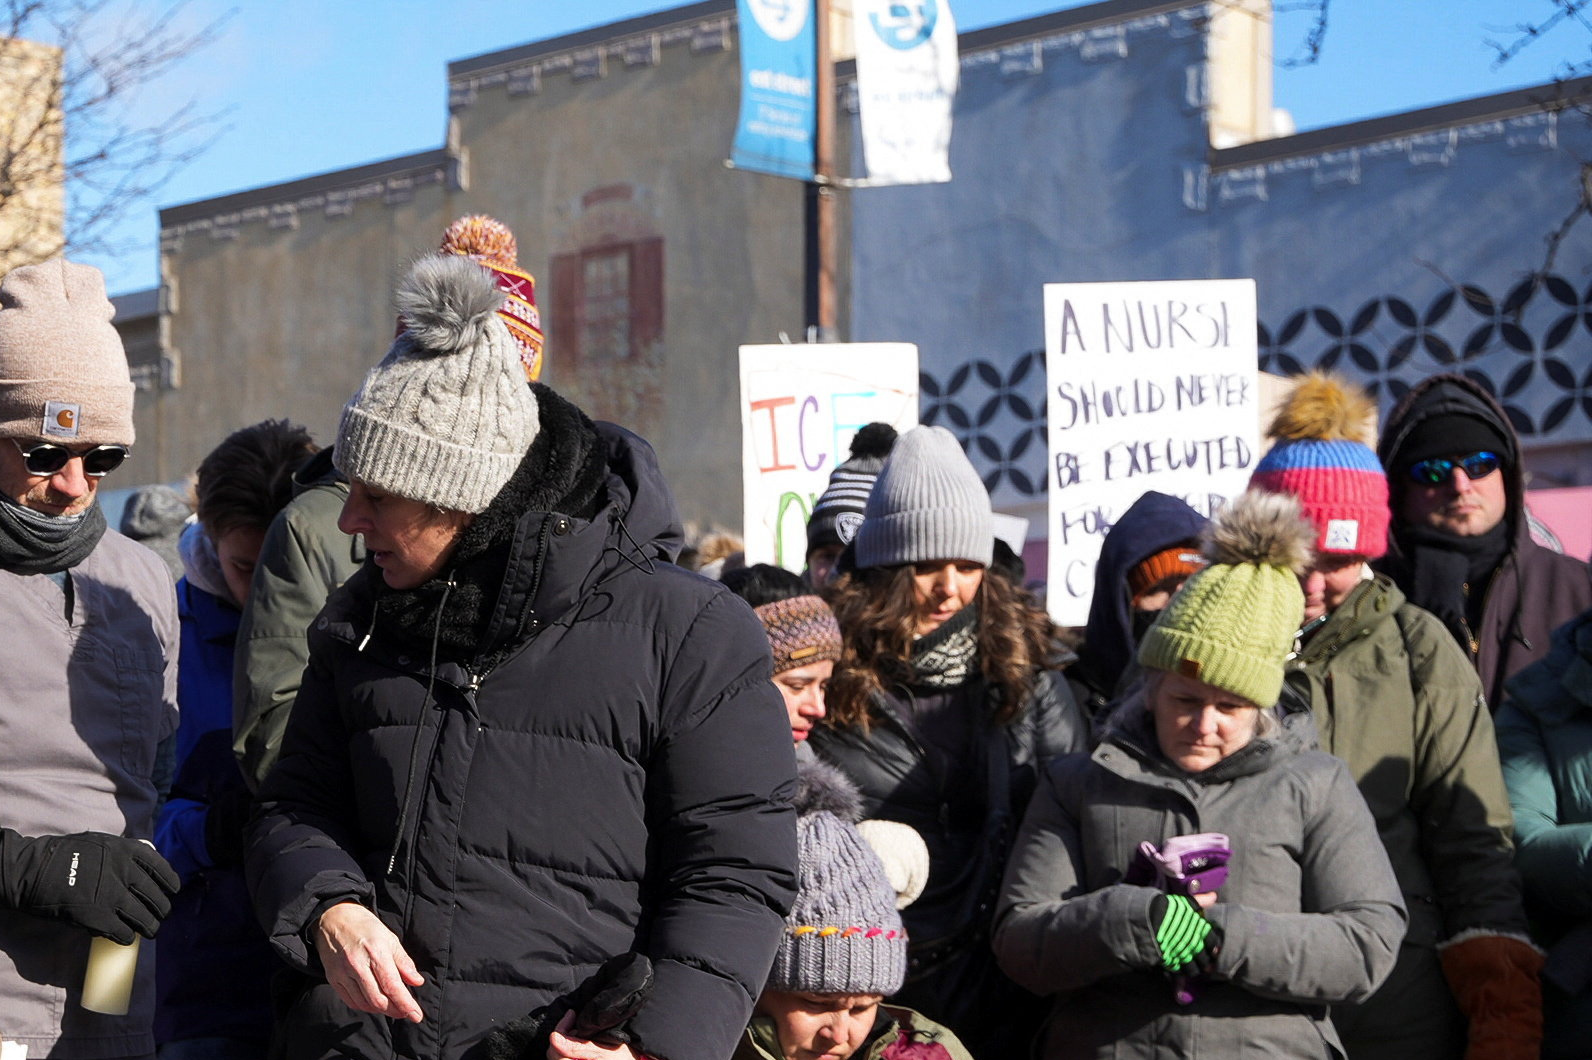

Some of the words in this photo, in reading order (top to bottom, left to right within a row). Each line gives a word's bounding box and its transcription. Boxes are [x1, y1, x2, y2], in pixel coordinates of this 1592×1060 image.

[1061, 299, 1086, 354] A
[1058, 377, 1165, 430] SHOULD
[1176, 373, 1249, 412] NEVER
[750, 391, 876, 474] ICE
[1056, 452, 1090, 489] BE
[1104, 436, 1251, 481] EXECUTED
[68, 852, 79, 886] HEAD
